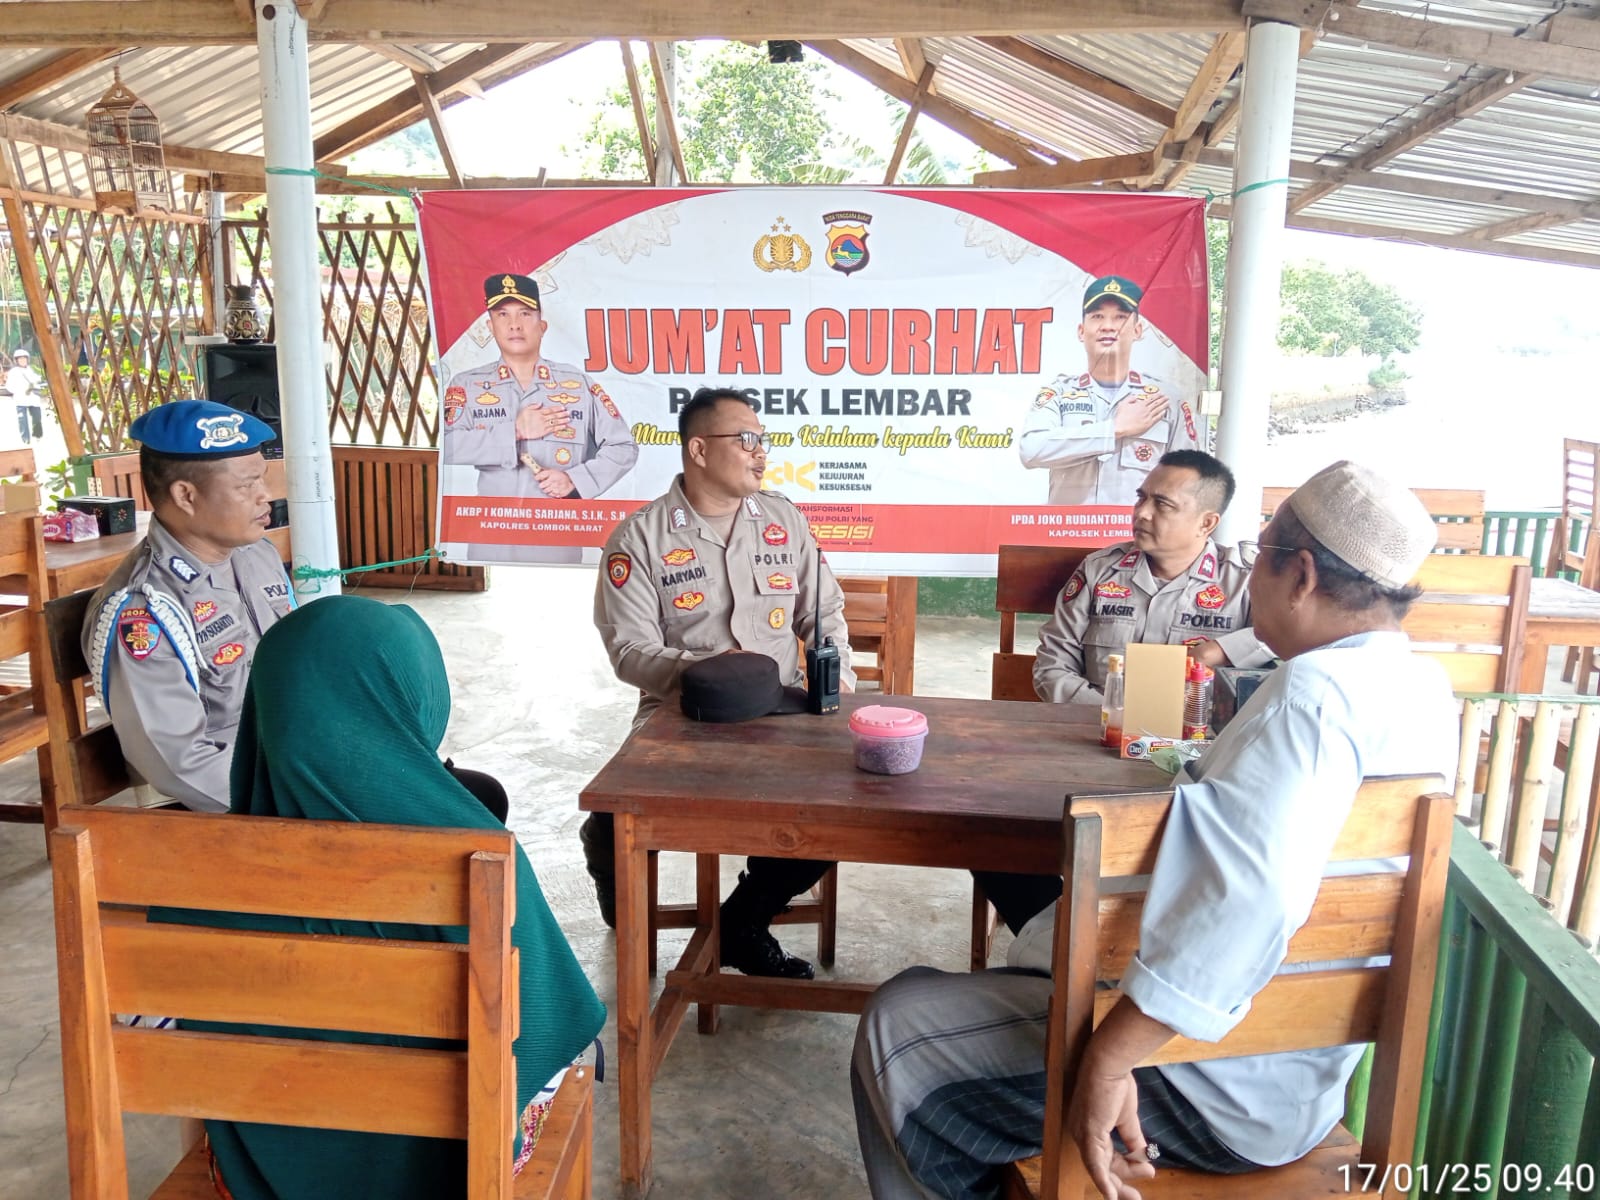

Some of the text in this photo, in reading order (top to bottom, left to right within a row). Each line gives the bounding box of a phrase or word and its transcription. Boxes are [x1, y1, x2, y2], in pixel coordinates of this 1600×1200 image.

[584, 307, 1054, 375] JUM'AT CURHAT
[668, 387, 972, 416] PSEK LEMBAR
[472, 407, 507, 419] ARJANA
[798, 424, 879, 448] Keluhan
[883, 426, 952, 456] kepada
[955, 427, 1014, 448] Kami
[819, 461, 867, 470] KERJASAMA
[819, 472, 865, 481] KEJUJURAN
[819, 483, 872, 492] KESUKSESAN
[455, 507, 482, 518] AKBP
[484, 507, 488, 517] I
[490, 508, 533, 519] KOMANG
[825, 515, 850, 523] POLRI
[1011, 514, 1132, 525] IPDA JOKO RUDIANTORO
[480, 521, 603, 533] KAPOLRES LOMBOK BARAT
[1048, 529, 1133, 538] KAPOLSEK LEMB
[755, 553, 793, 566] POLRI
[661, 566, 708, 588] KARYADI
[1101, 604, 1135, 617] NASIR
[1180, 612, 1233, 629] POLRI
